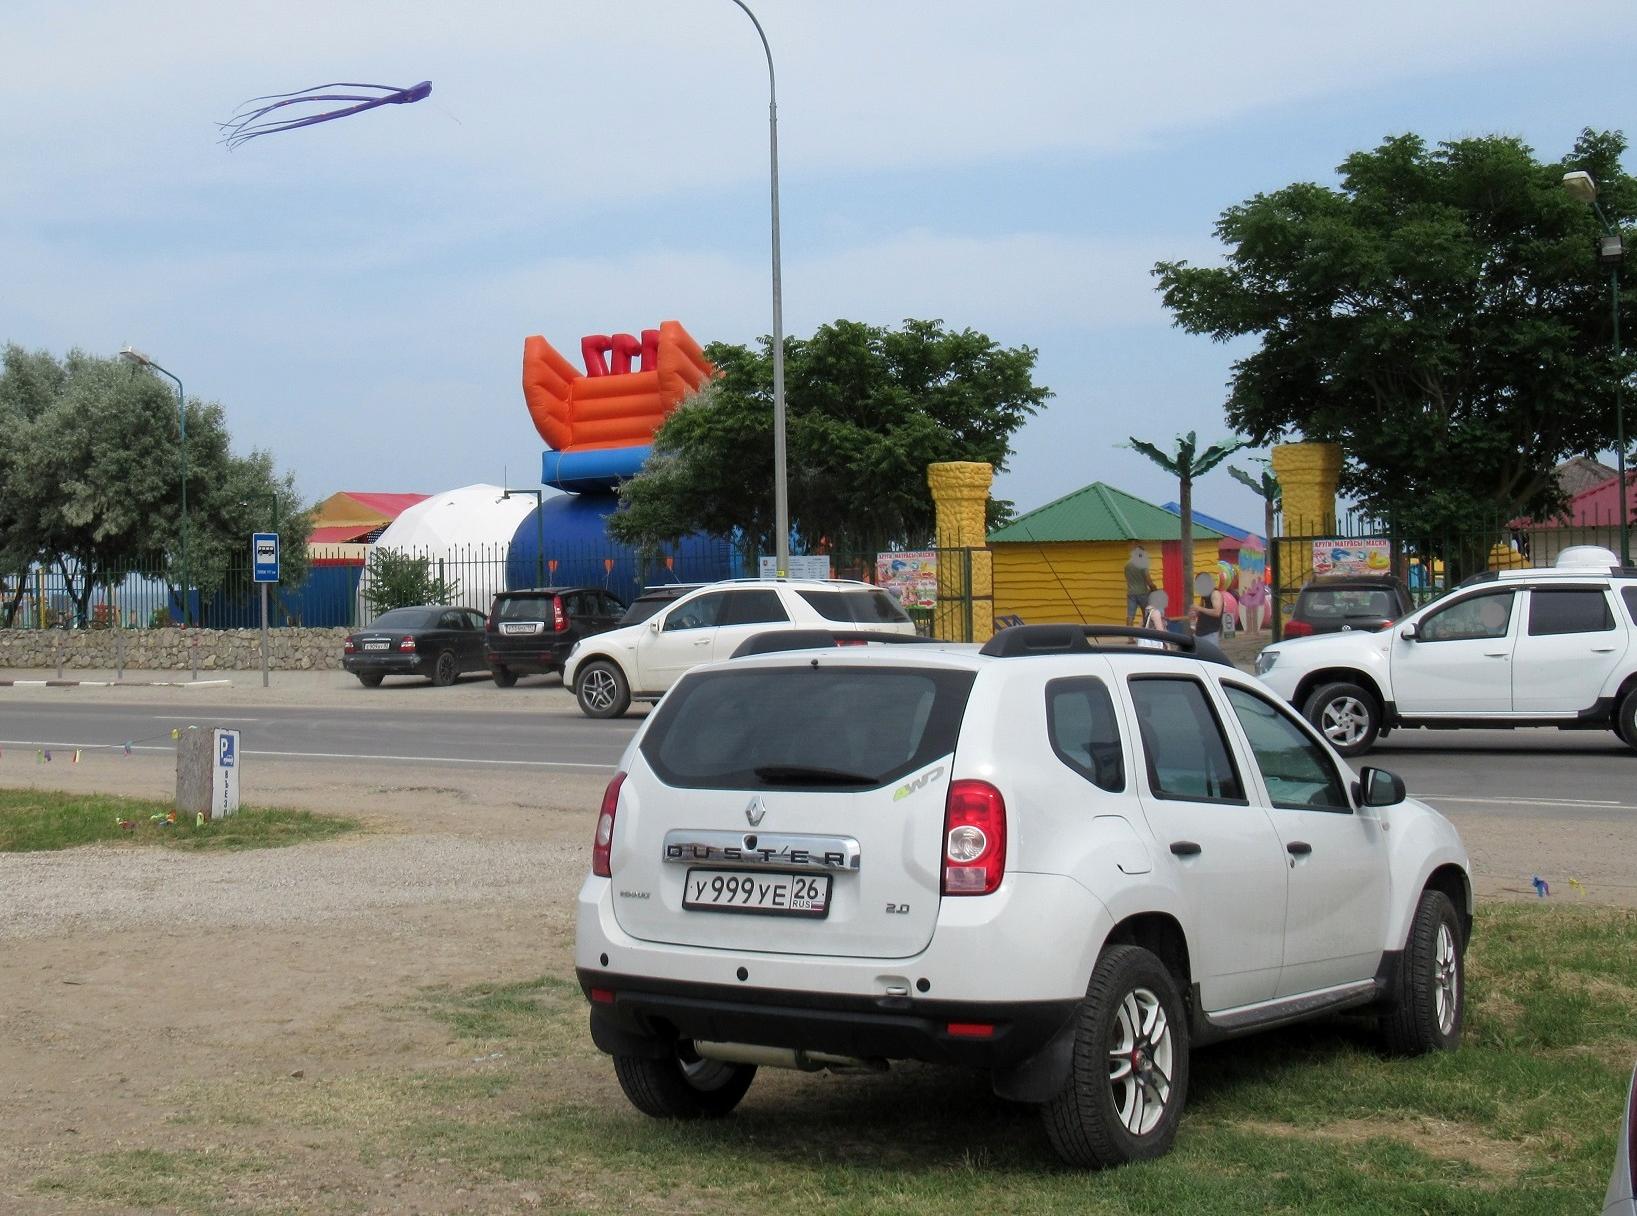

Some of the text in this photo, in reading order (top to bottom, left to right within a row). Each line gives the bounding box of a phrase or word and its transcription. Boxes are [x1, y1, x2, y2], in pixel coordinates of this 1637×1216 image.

[667, 845, 845, 866] DUSTER
[794, 878, 819, 900] 26
[792, 899, 811, 909] RUS
[885, 903, 911, 915] 2.0
